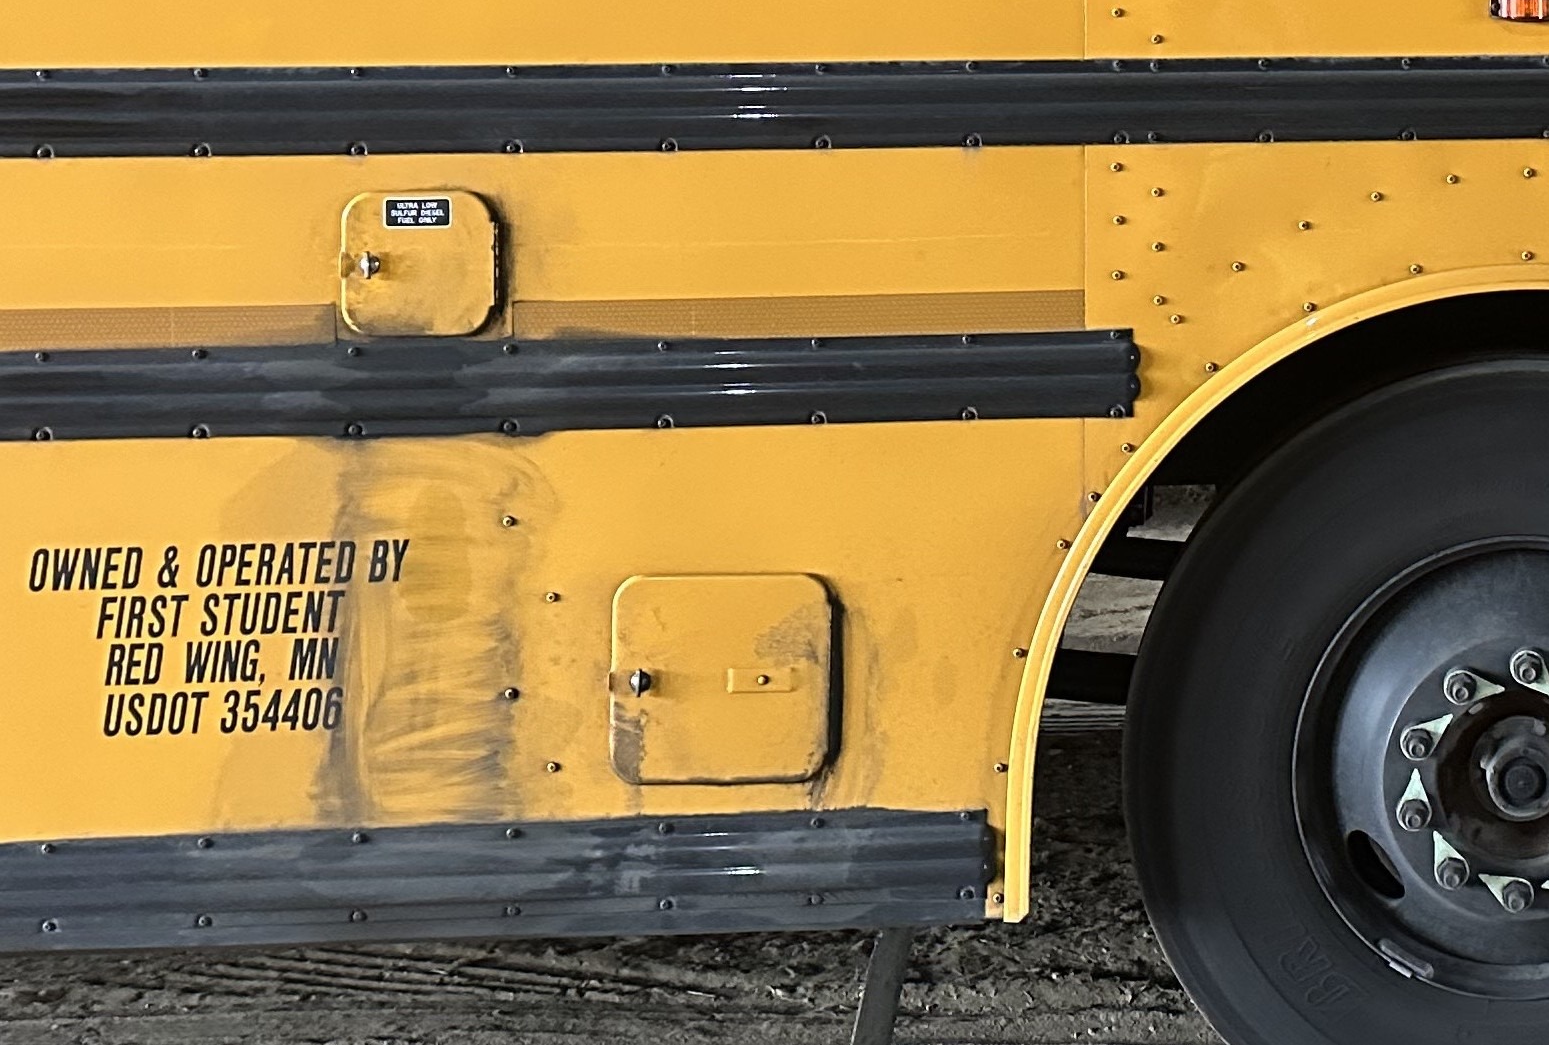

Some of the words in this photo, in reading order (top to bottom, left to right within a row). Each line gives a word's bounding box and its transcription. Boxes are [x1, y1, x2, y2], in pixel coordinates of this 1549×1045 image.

[397, 216, 416, 224] FUEL
[418, 216, 437, 224] ONLY
[421, 201, 438, 209] LOW
[30, 547, 143, 592] OWNED
[158, 546, 180, 588] &
[196, 540, 356, 588] OPERATED
[368, 538, 410, 583] BY
[97, 594, 190, 639] FIRST
[200, 589, 345, 636] STUDENT
[105, 643, 164, 686] RED
[185, 640, 266, 686] WING,
[289, 637, 340, 681] MN
[103, 691, 209, 737] USDOT
[220, 687, 343, 733] 354406
